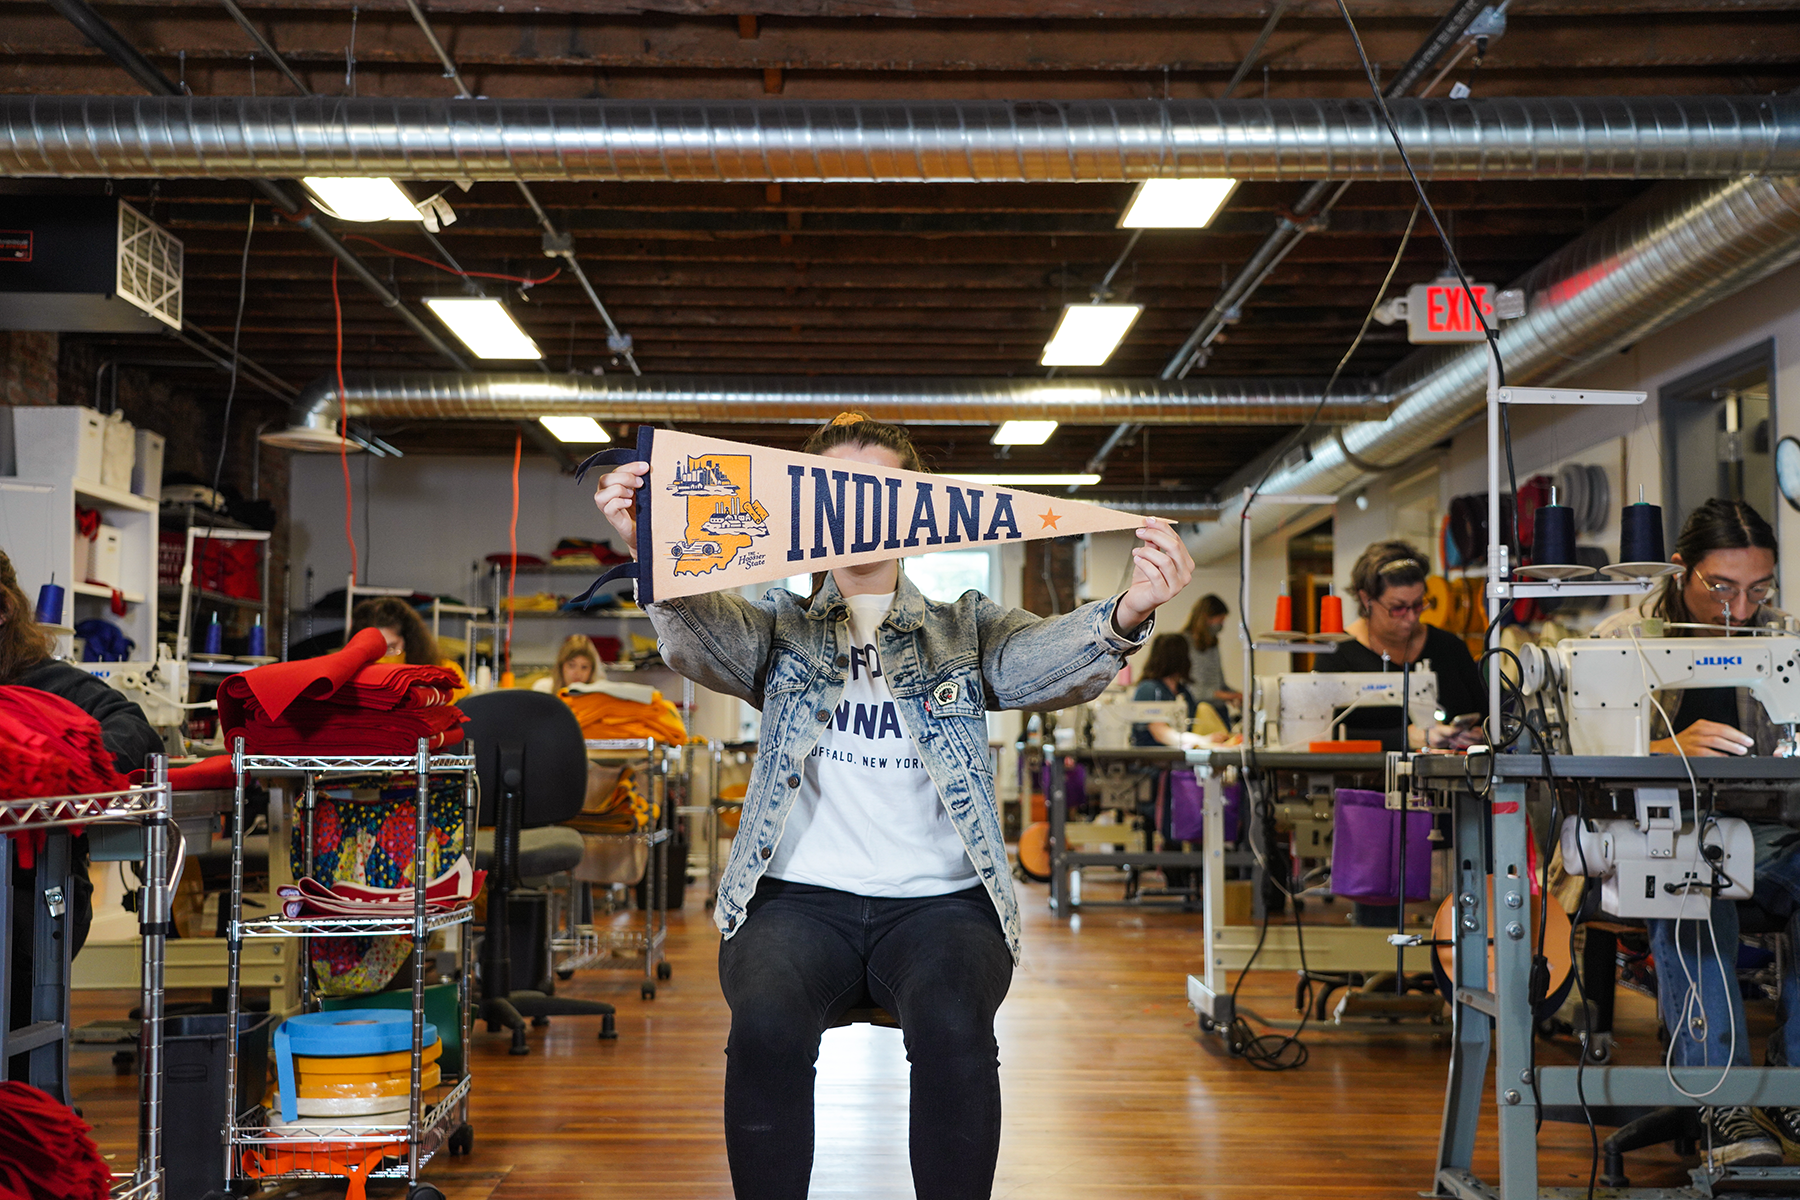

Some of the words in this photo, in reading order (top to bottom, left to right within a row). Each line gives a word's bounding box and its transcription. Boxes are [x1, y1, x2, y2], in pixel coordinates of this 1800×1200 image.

[1426, 286, 1487, 333] EXIT
[787, 464, 1022, 562] INDIANA
[738, 552, 766, 565] Hoosier
[745, 560, 765, 570] State
[1696, 656, 1742, 665] JUKI
[862, 756, 888, 769] NEW
